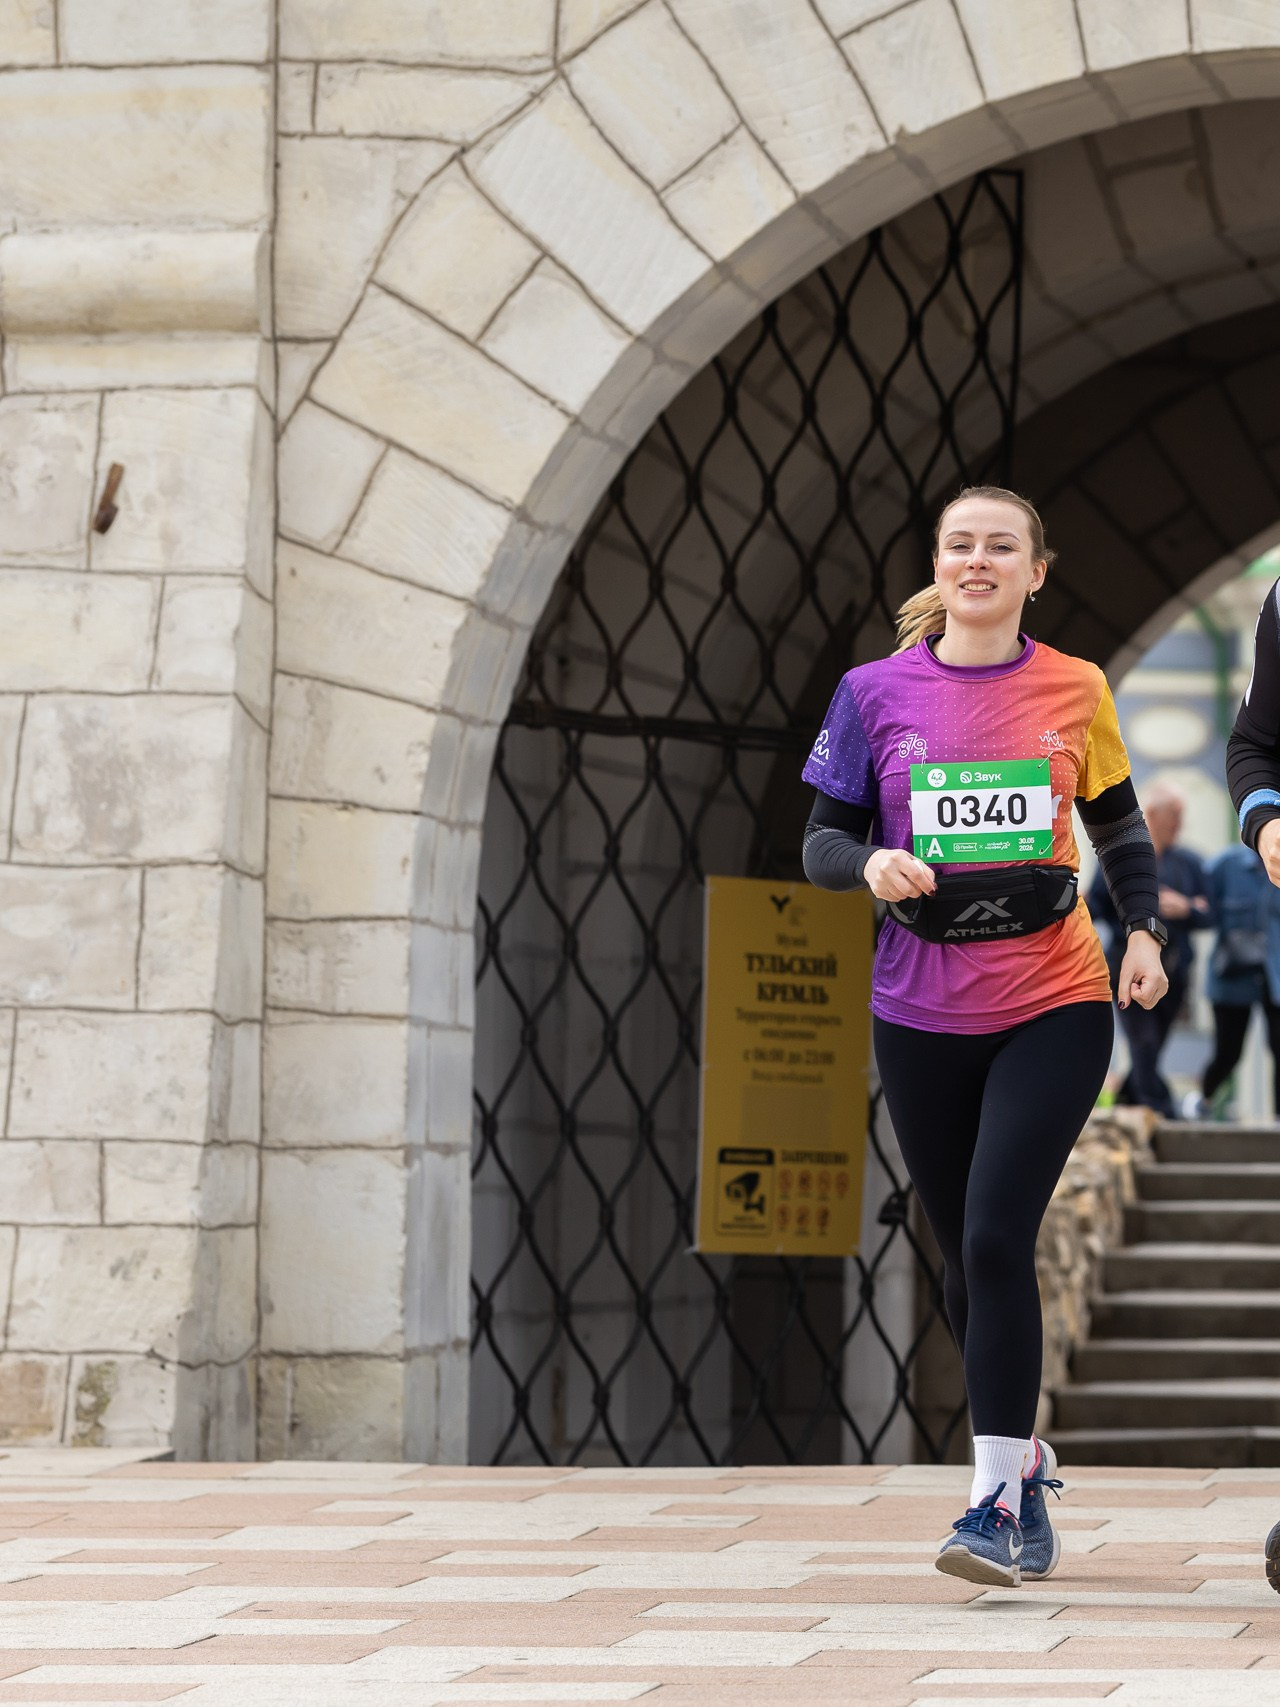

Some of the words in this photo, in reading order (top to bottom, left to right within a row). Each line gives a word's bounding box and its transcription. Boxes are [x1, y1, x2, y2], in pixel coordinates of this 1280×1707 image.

[973, 772, 1002, 784] Звук
[937, 792, 1028, 828] 0340
[943, 921, 1024, 938] ATHLEX
[744, 951, 838, 978] ТУЛЬСКИЙ
[756, 982, 830, 1005] КРЕМЛЬ
